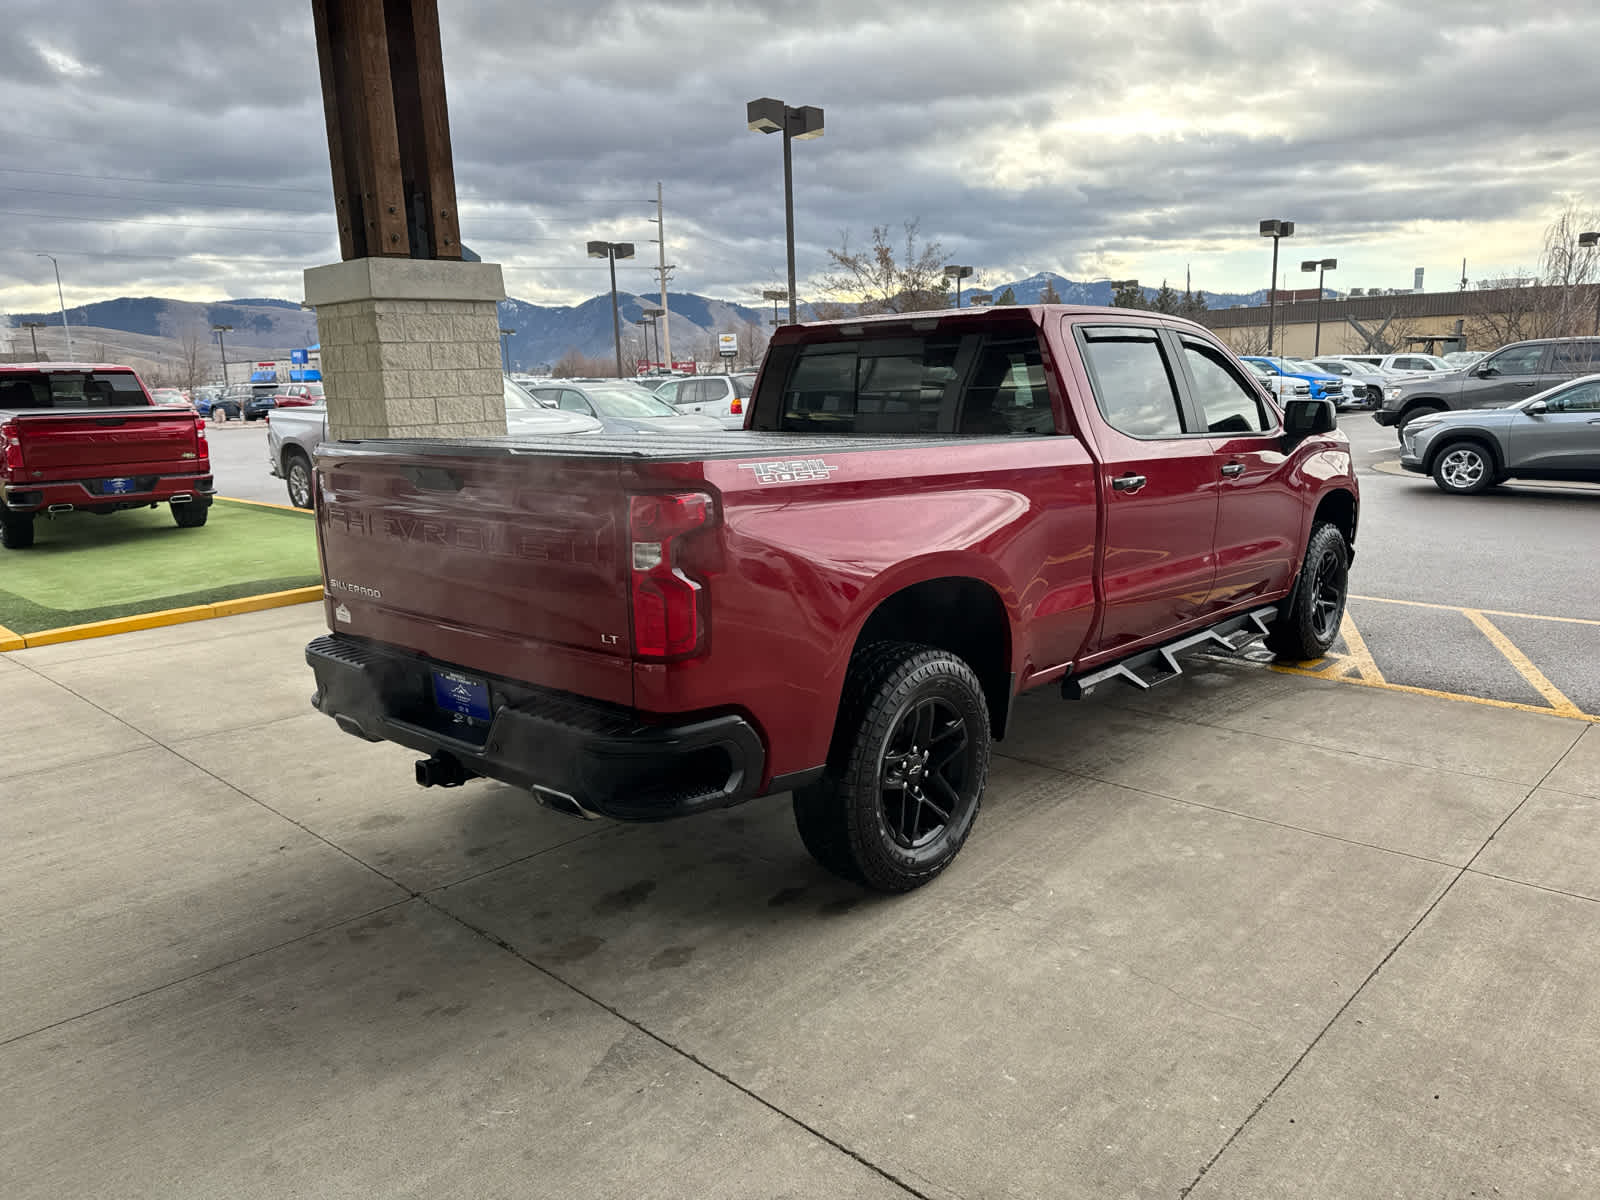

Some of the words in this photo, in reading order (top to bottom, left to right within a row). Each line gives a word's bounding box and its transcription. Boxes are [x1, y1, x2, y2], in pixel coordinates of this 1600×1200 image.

[738, 459, 838, 475] TRAIL
[757, 470, 830, 484] BOSS
[330, 579, 382, 598] SILVERADO
[601, 634, 619, 644] LT
